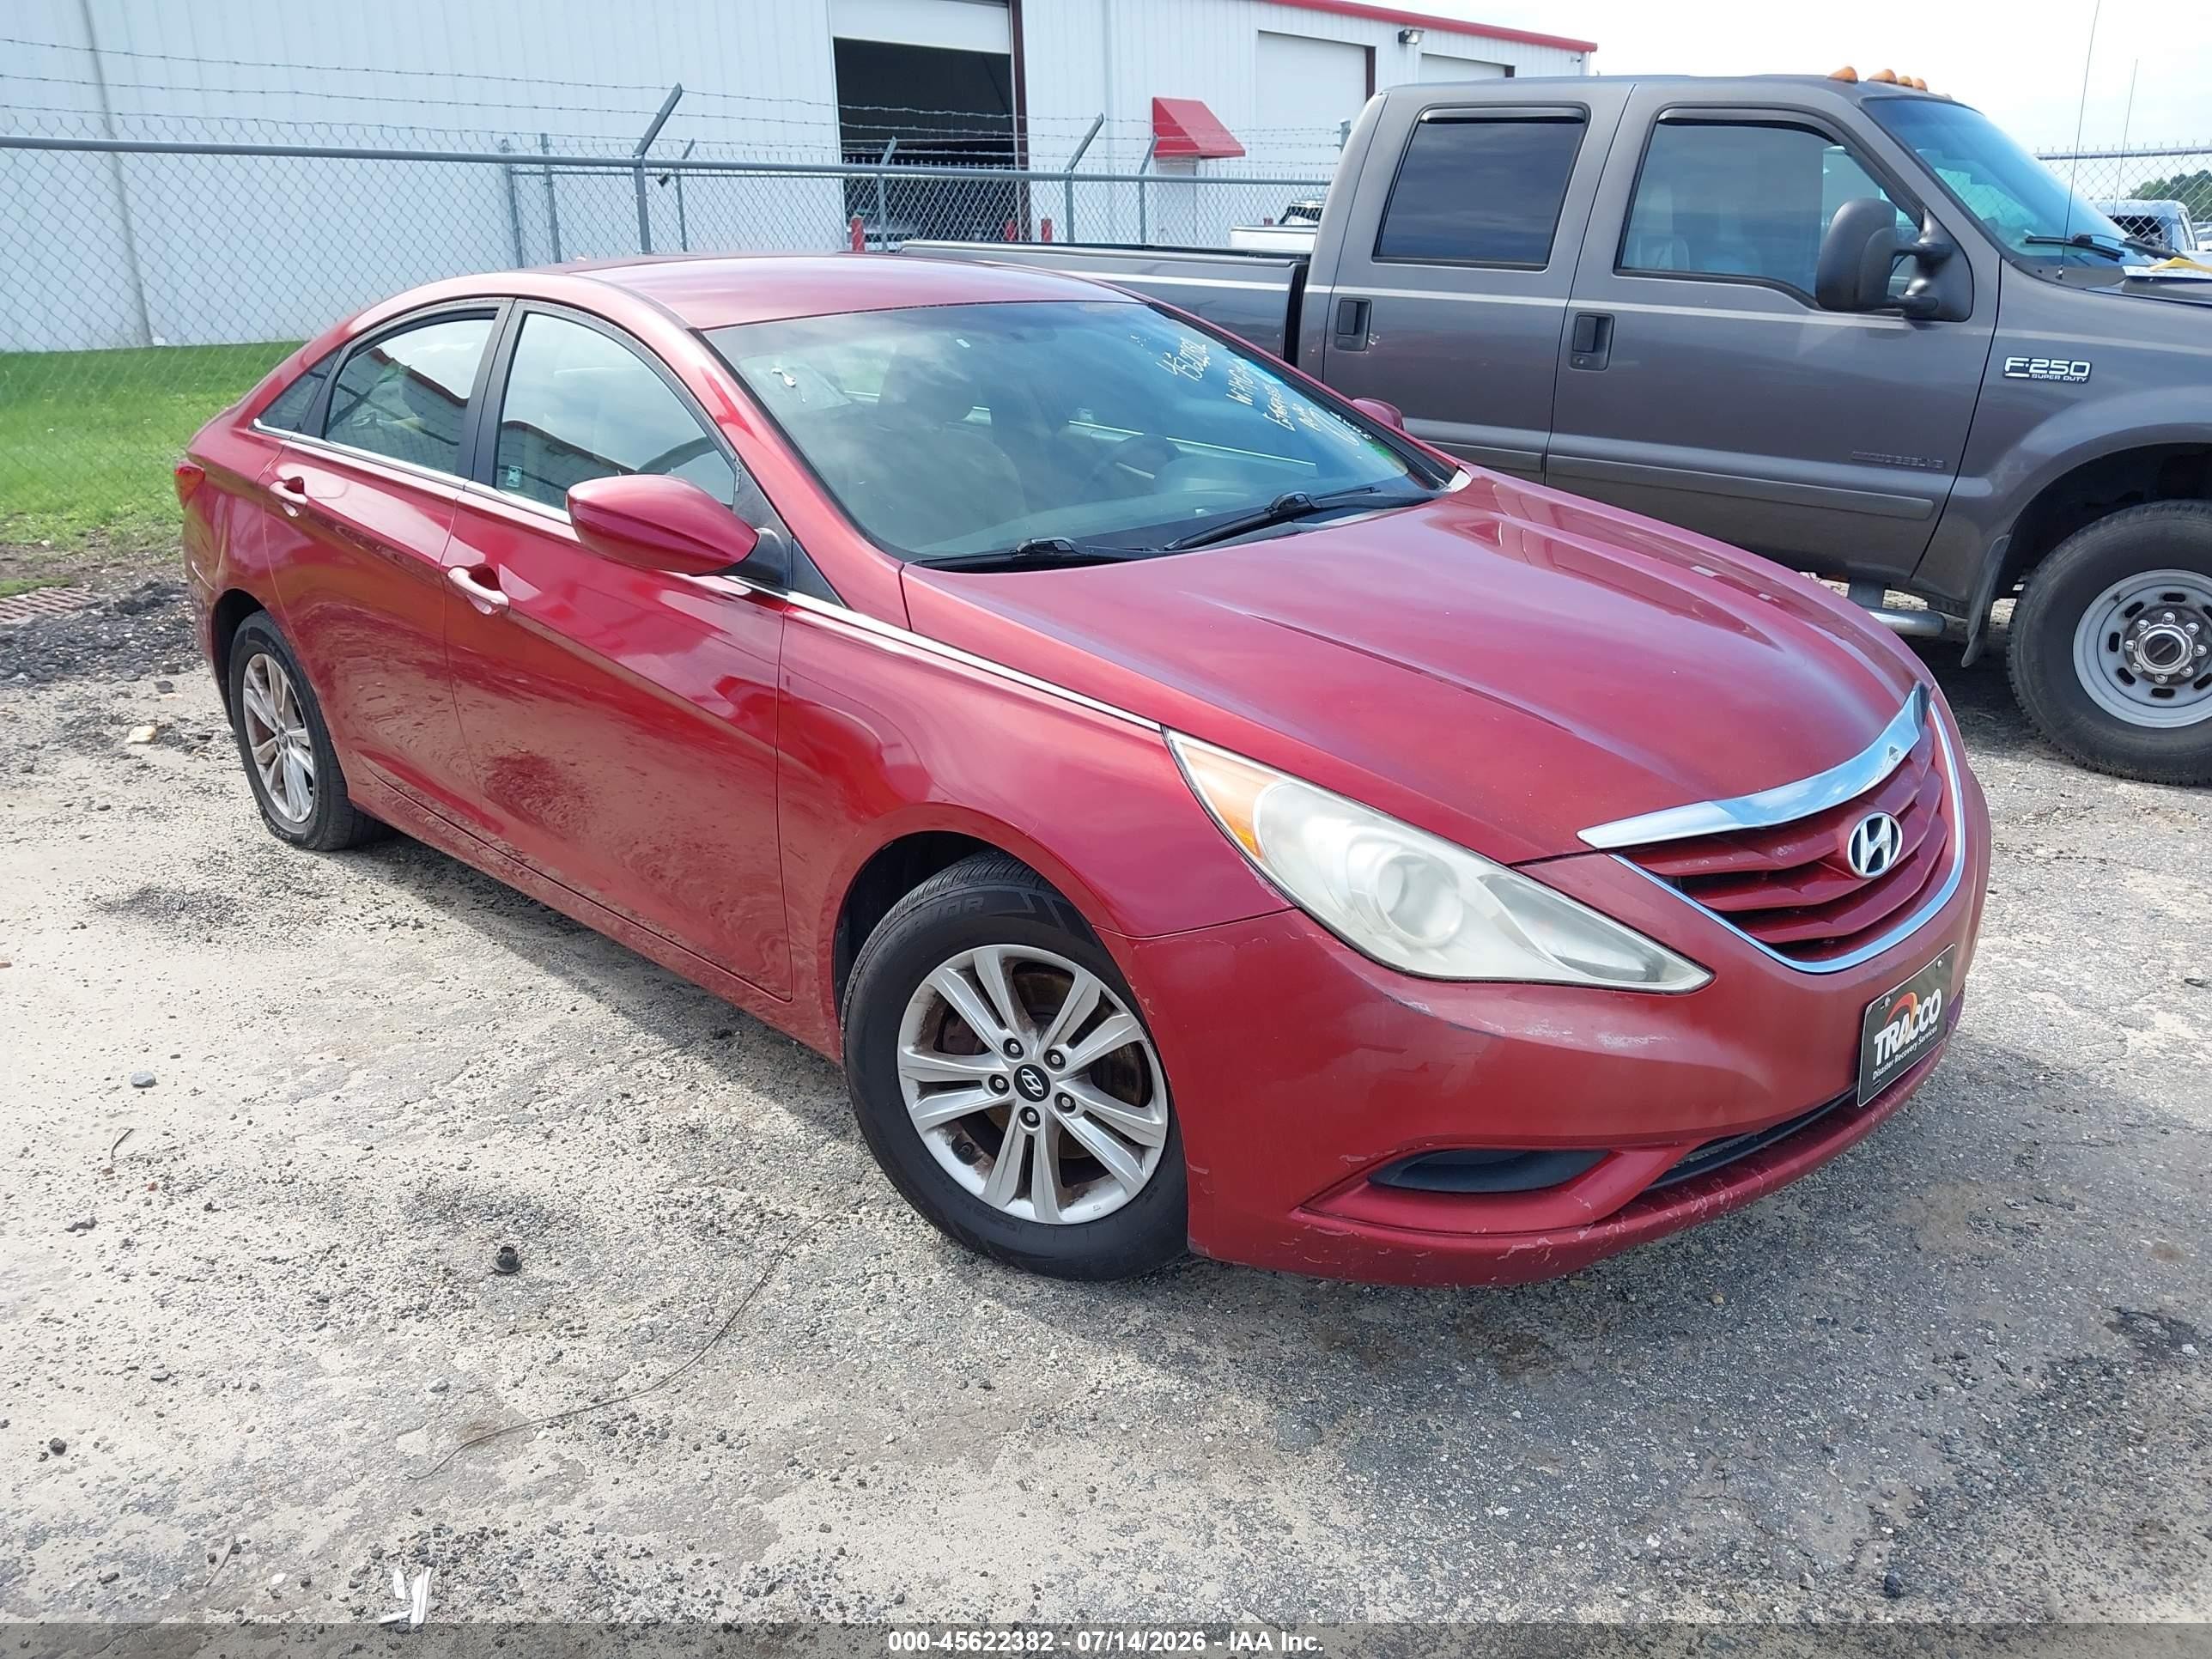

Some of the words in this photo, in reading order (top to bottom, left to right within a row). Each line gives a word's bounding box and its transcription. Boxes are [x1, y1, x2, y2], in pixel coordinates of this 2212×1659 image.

[1872, 1058, 1893, 1081] Disaster
[1894, 1040, 1919, 1064] Recovery
[1917, 1024, 1938, 1045] Services
[1874, 988, 1942, 1066] TRACCO
